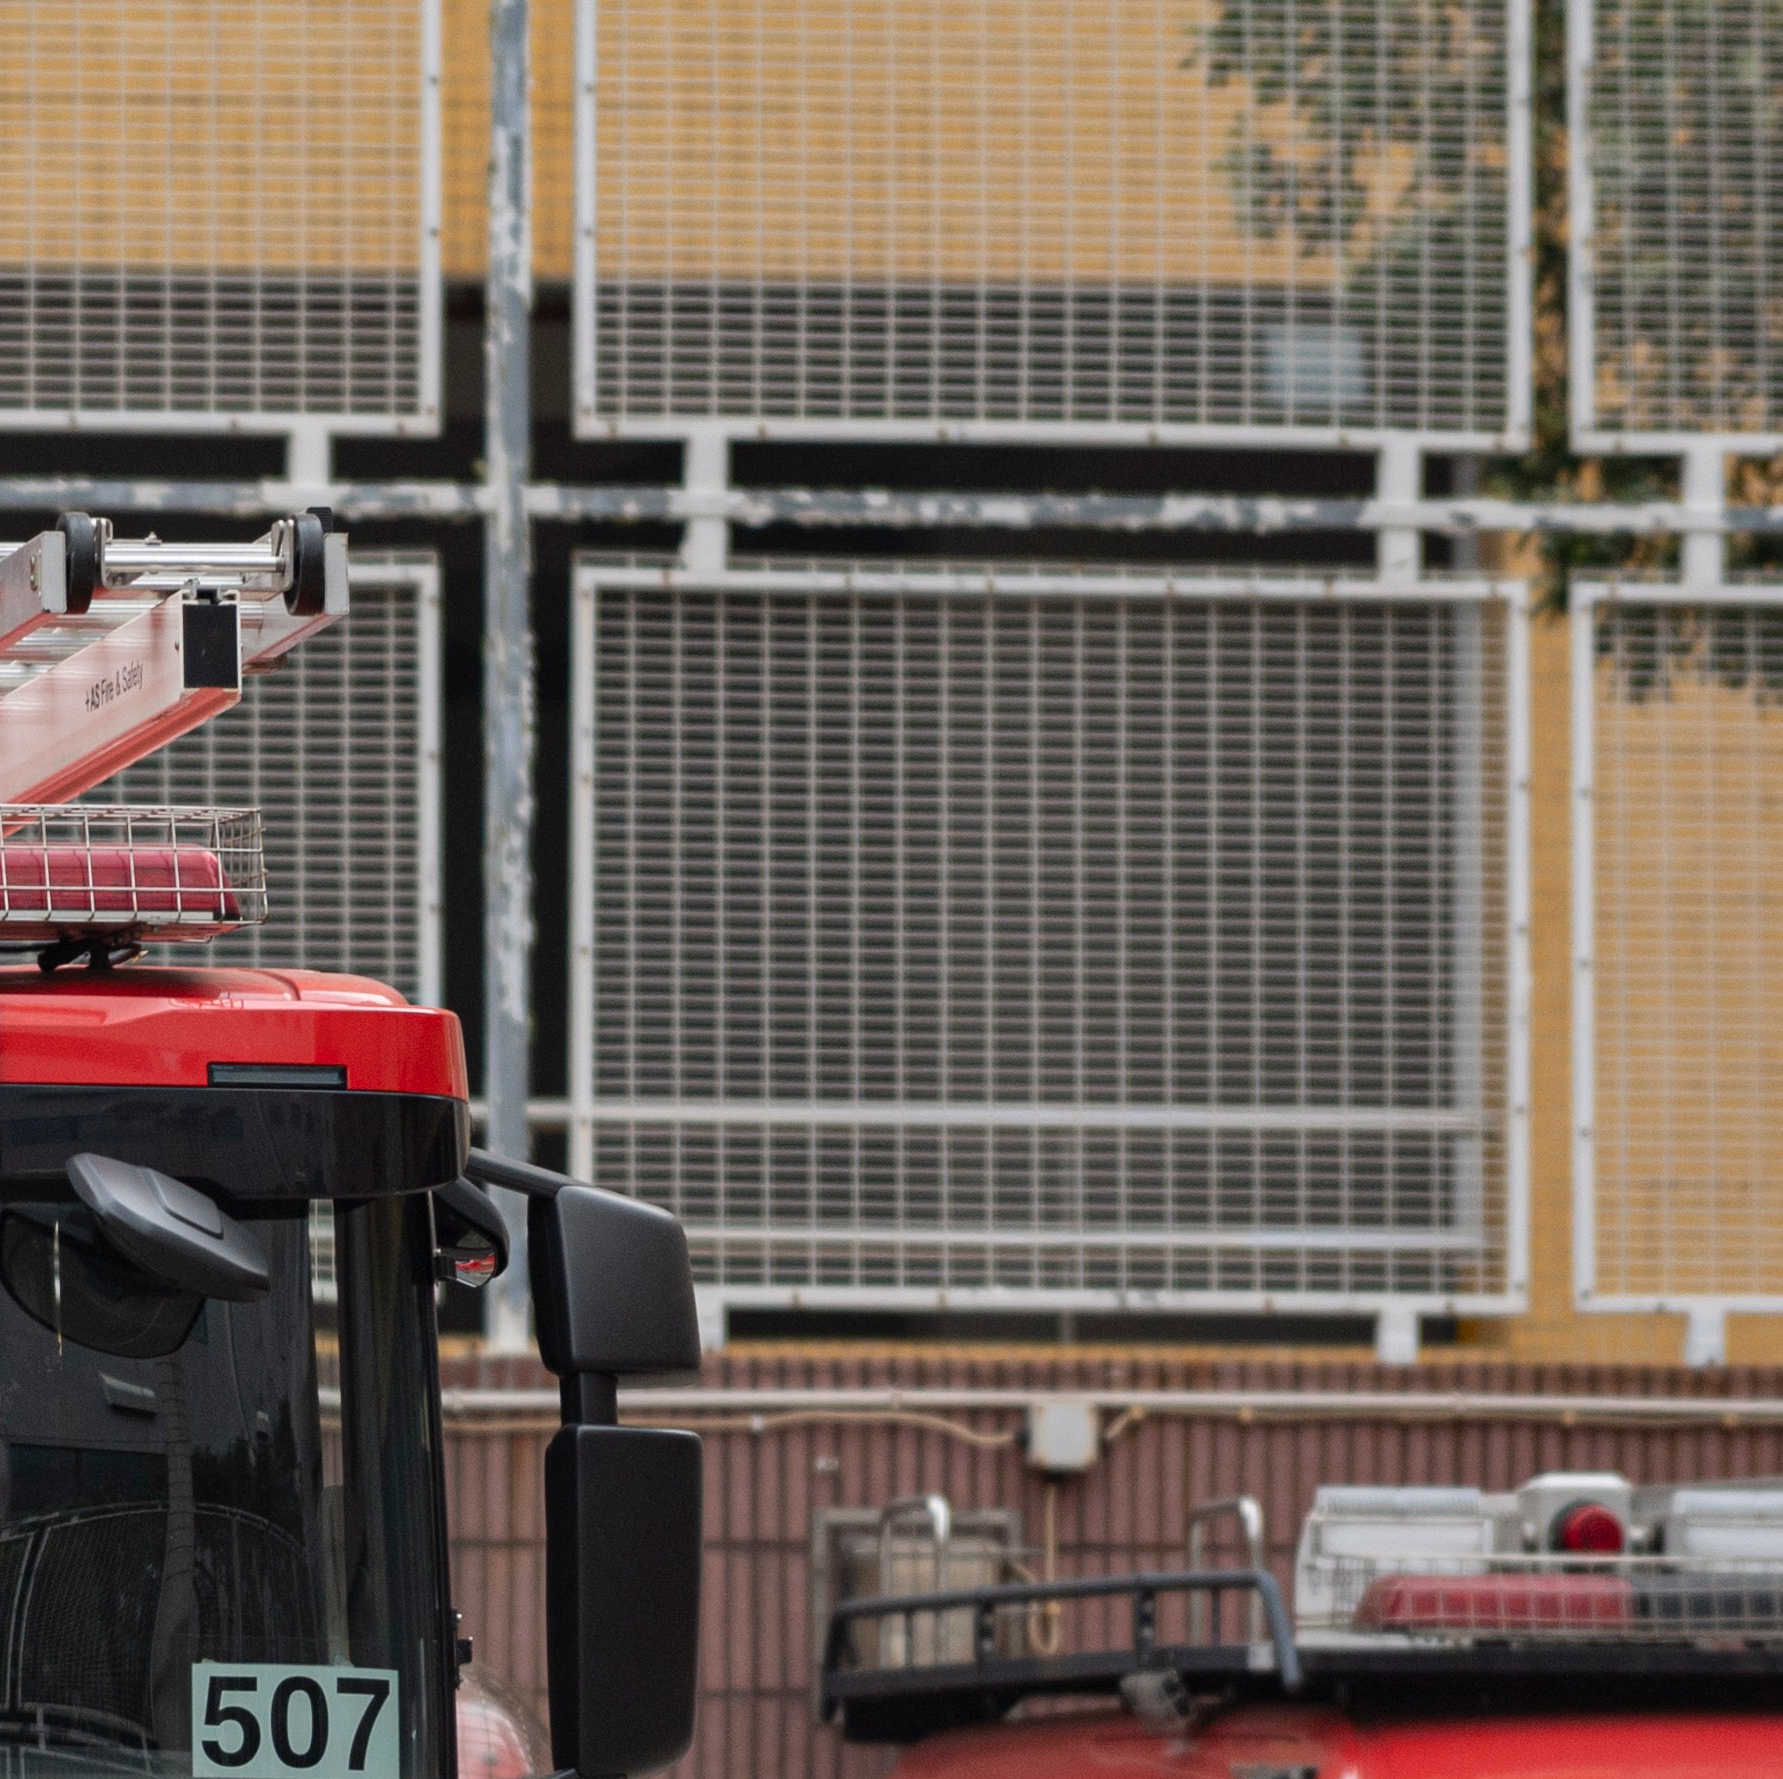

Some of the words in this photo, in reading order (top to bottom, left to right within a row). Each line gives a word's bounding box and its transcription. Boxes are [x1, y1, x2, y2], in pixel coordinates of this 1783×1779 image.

[101, 678, 114, 705] Fire
[115, 670, 121, 697] &
[122, 660, 144, 693] Safety
[201, 1676, 390, 1771] 507
